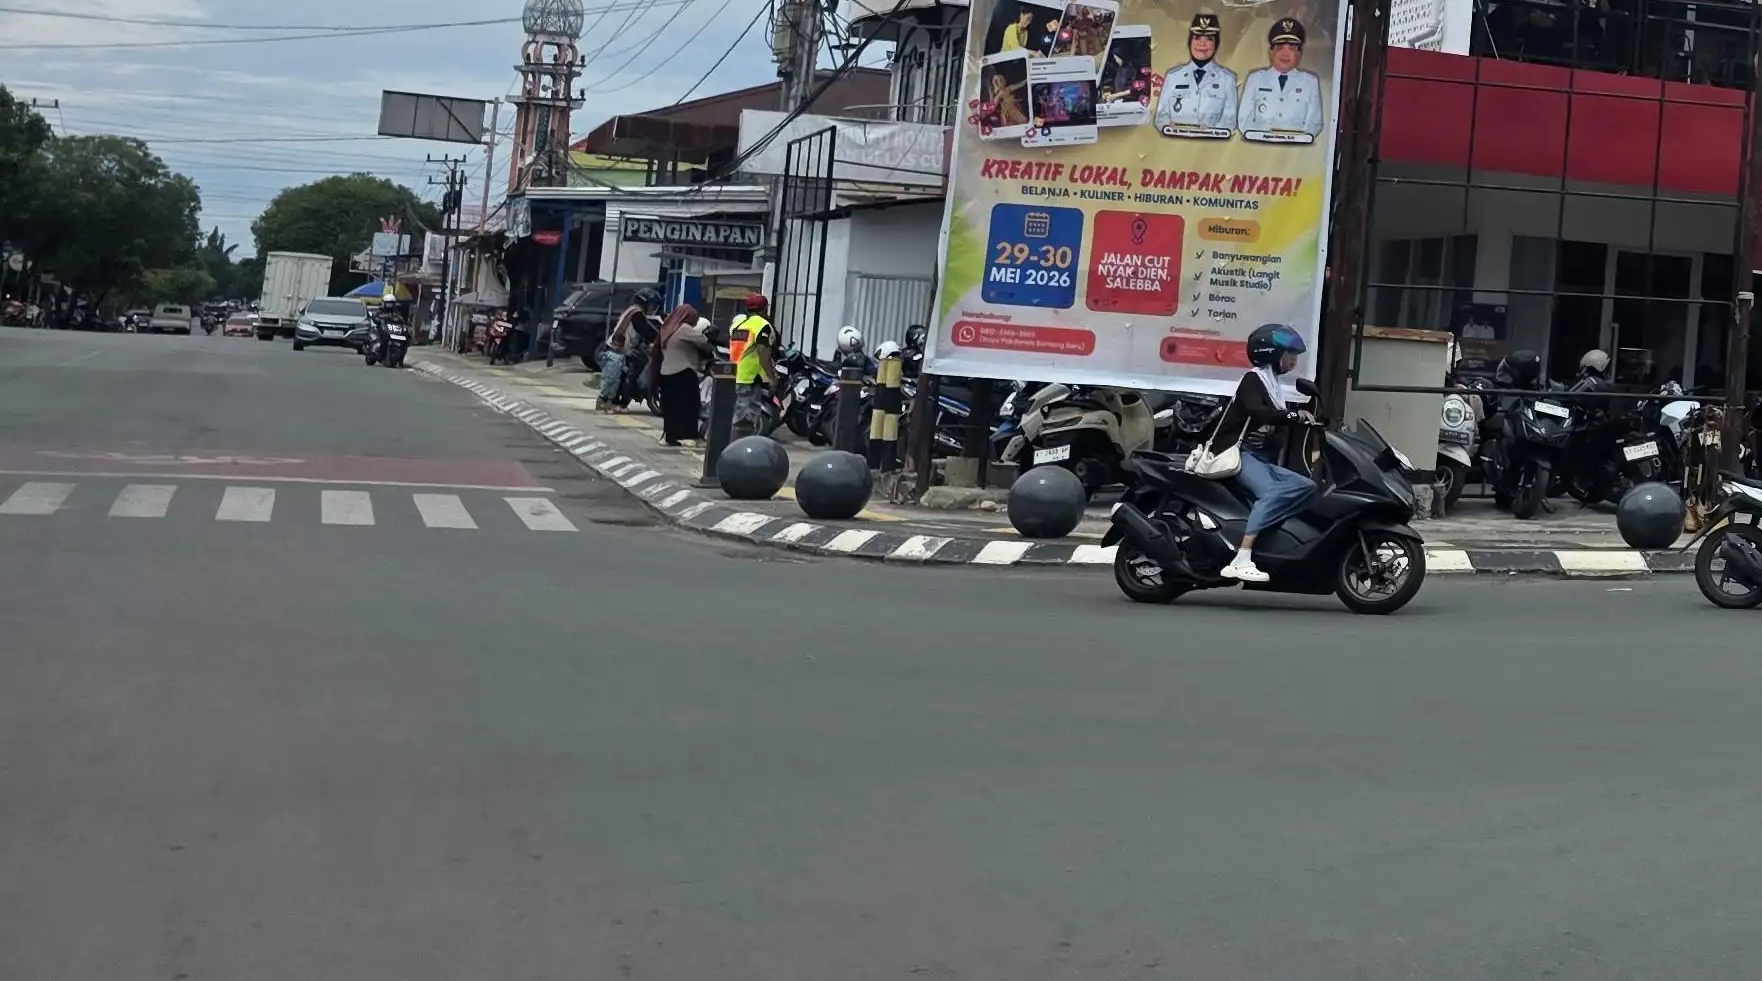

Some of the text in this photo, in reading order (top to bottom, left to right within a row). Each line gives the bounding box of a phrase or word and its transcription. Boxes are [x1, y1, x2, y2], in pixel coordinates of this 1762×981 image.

[981, 158, 1303, 197] KREATIF LOKAL, DAMPAK NYATA!
[1021, 185, 1260, 211] BELANJA KULINER HIBURAN KOMUNITAS
[625, 220, 759, 245] PENGINAPAN
[994, 241, 1073, 269] 29-30
[1101, 252, 1172, 269] JALAN CUT
[1212, 250, 1282, 265] Banyuwangian
[990, 267, 1071, 287] MEI 2026
[1098, 264, 1171, 282] NYAK DIEN,
[1211, 267, 1246, 278] Akustik
[1105, 277, 1162, 292] SALEBBA
[1210, 278, 1273, 292] Musik Studio)
